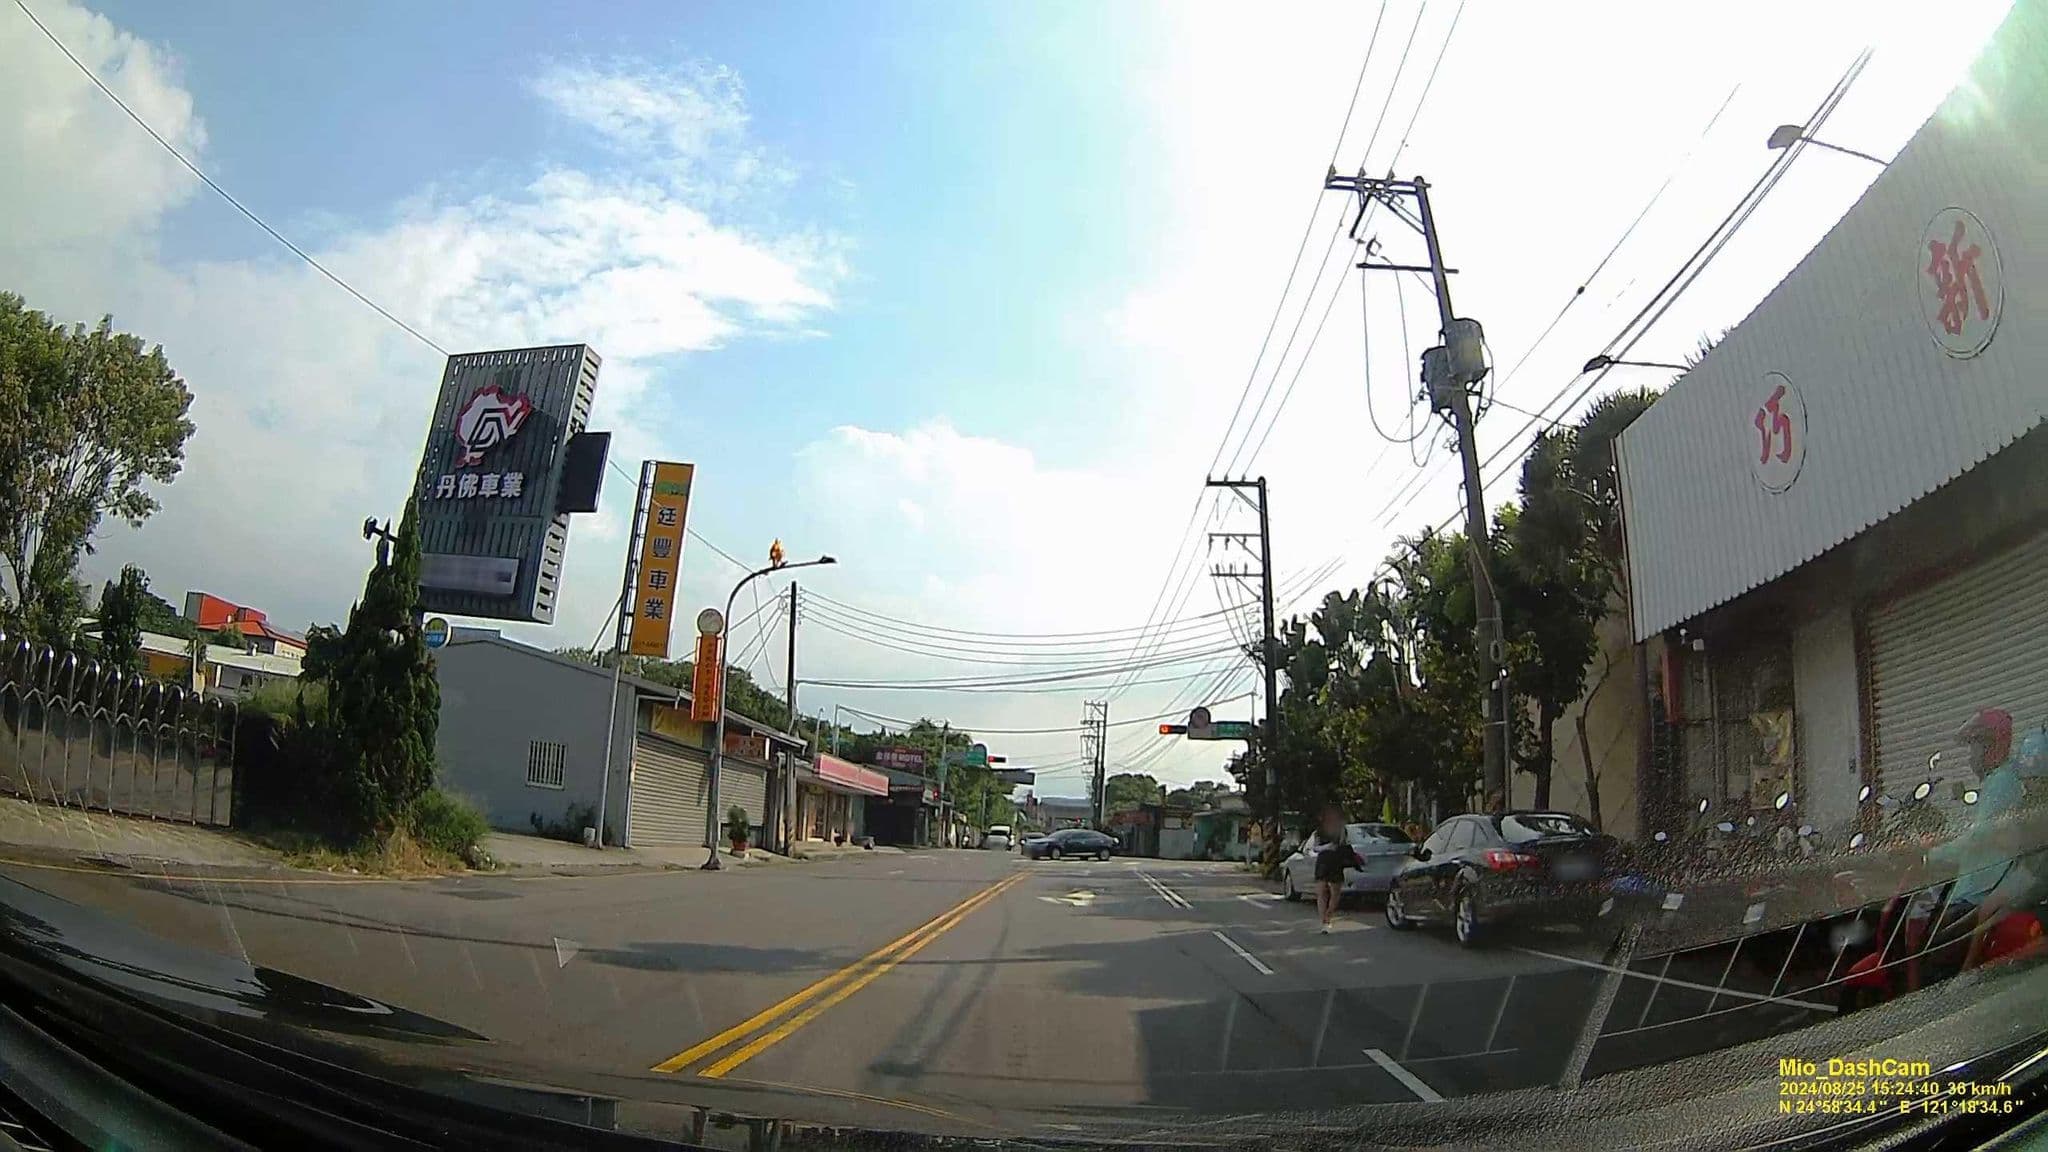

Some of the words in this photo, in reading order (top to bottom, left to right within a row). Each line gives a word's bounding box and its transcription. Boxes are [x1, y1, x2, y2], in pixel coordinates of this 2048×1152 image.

[1926, 219, 1990, 336] 新
[435, 471, 524, 499] 丹佛車業
